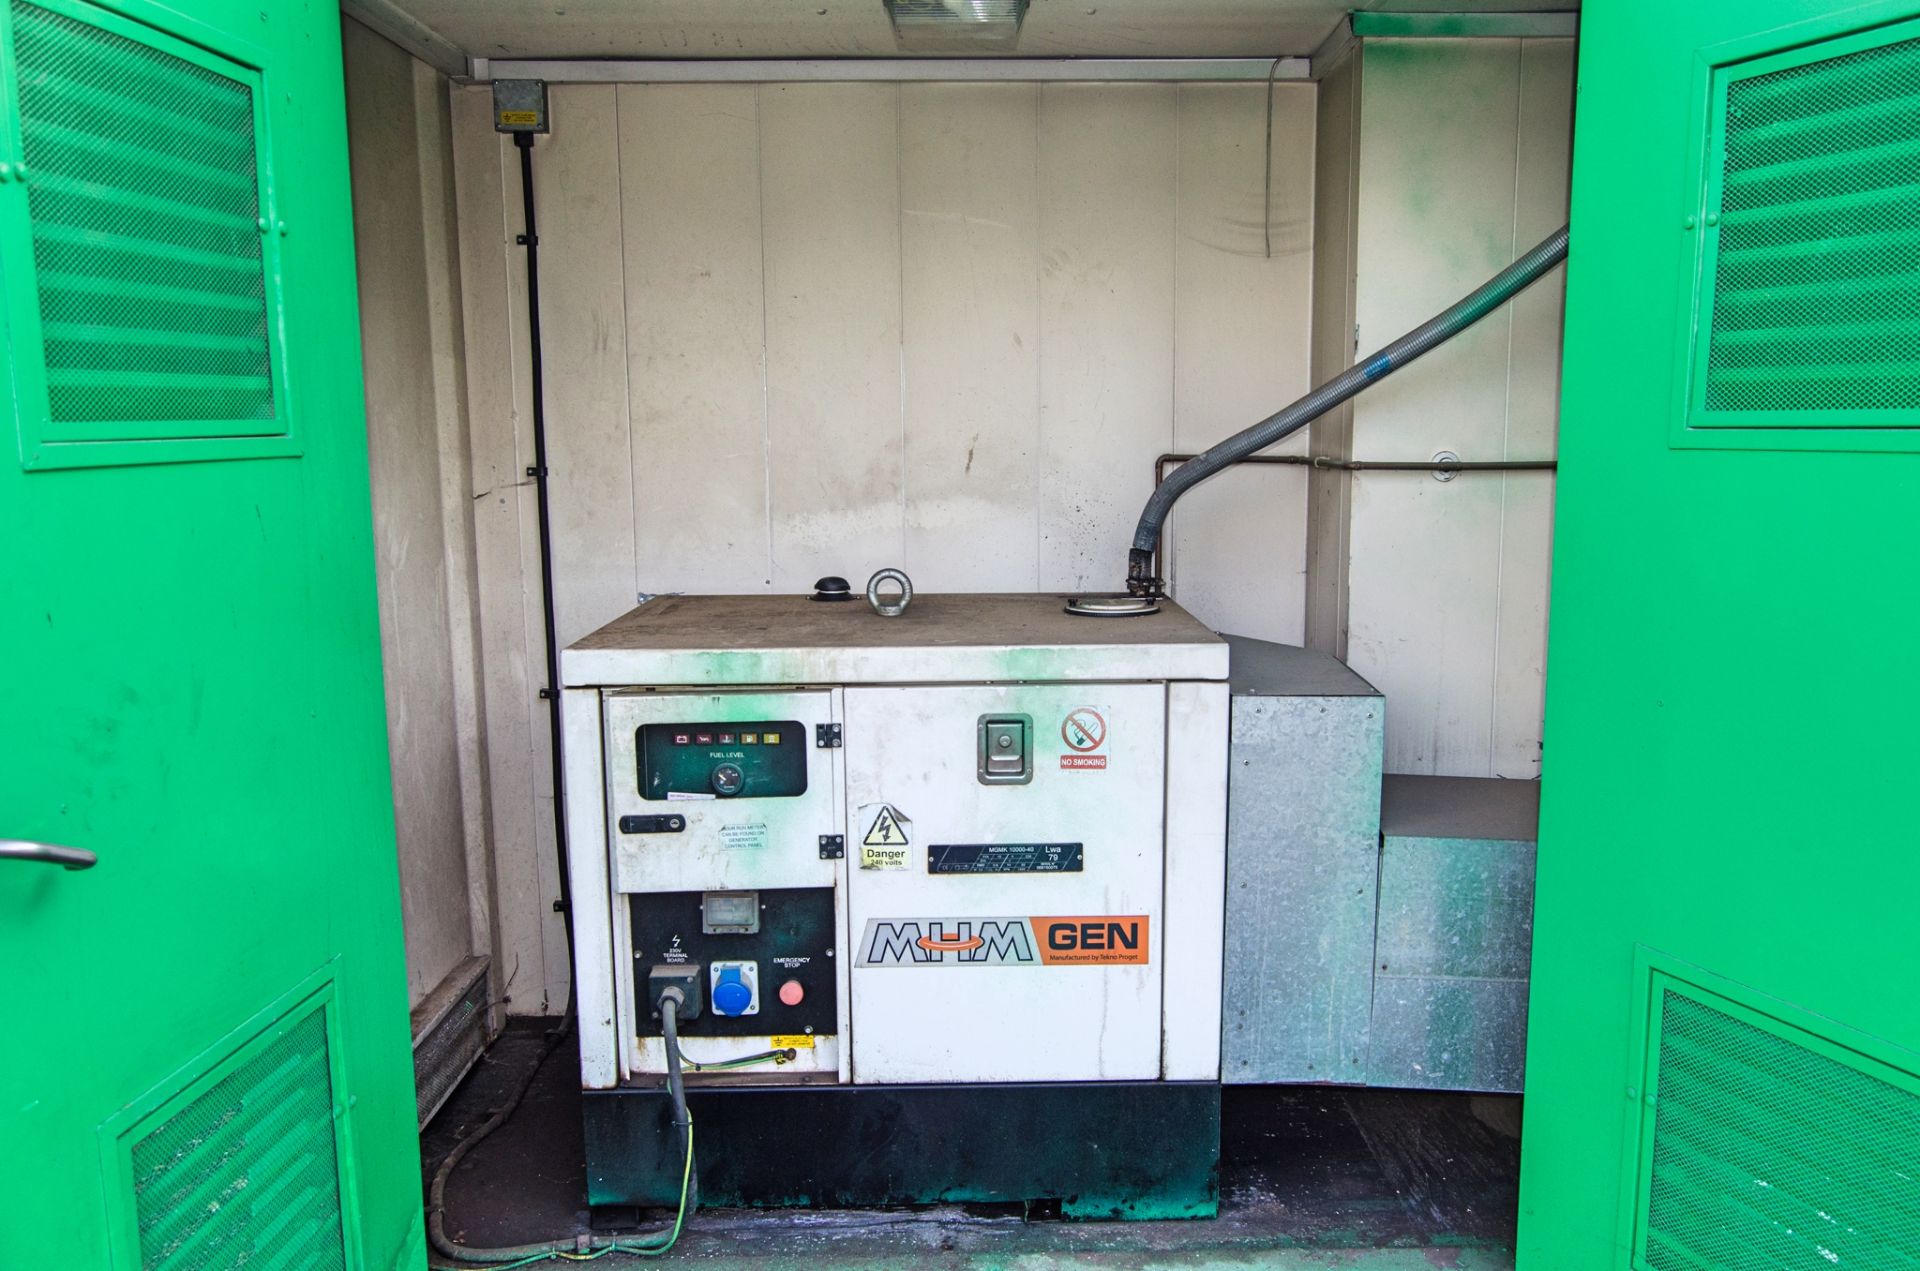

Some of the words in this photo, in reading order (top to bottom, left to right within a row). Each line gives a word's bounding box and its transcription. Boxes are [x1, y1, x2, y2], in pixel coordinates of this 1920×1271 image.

[1073, 758, 1106, 766] SMOKING
[1045, 845, 1062, 853] Lwa
[866, 849, 906, 860] Danger
[1048, 853, 1059, 861] 79
[1048, 923, 1139, 950] GEN
[1118, 953, 1138, 961] Proget
